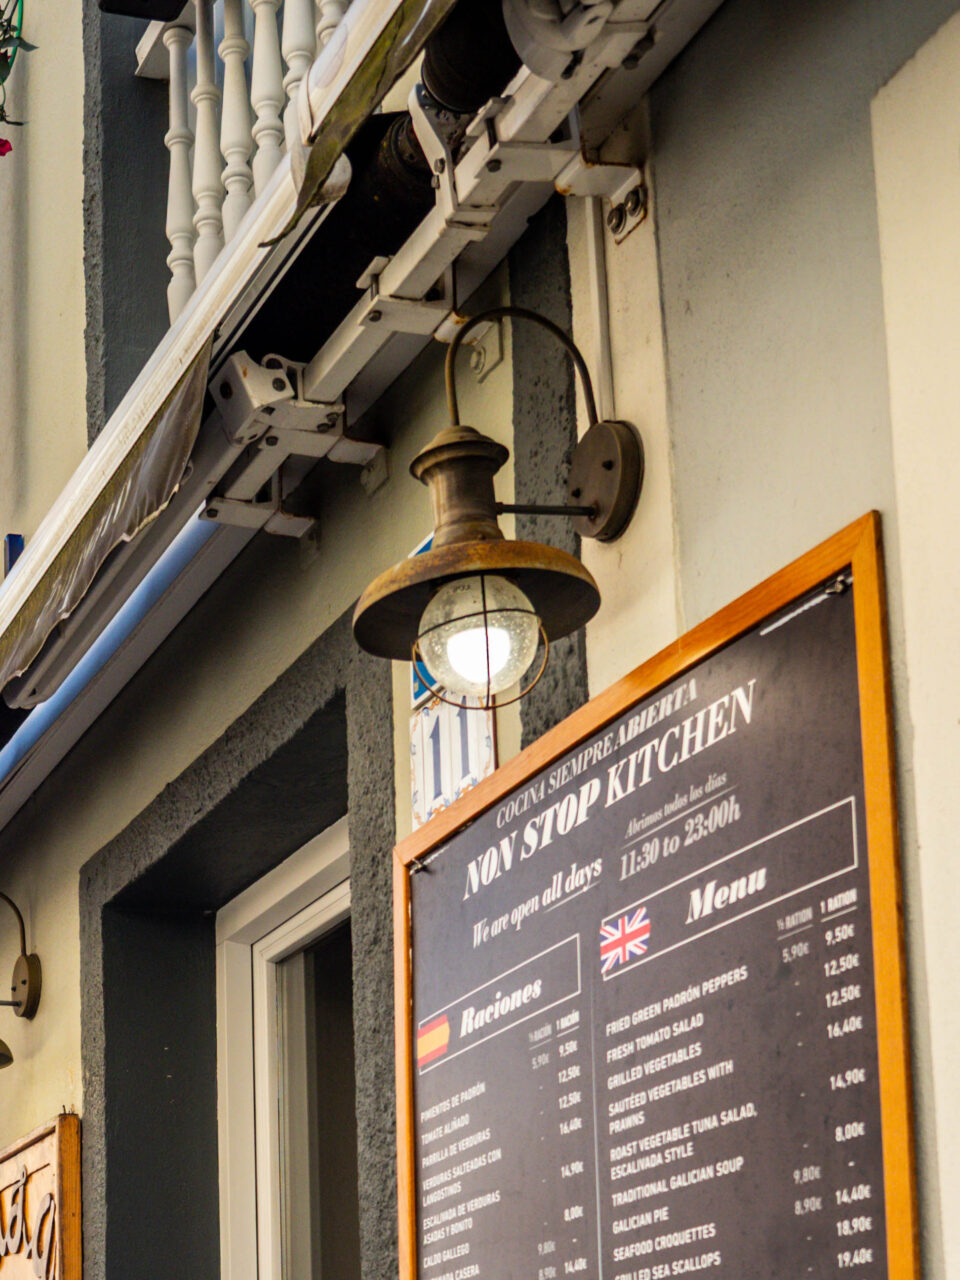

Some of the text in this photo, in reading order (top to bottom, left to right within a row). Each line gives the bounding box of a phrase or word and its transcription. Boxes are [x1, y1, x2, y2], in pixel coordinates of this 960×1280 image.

[429, 694, 471, 801] 11
[496, 678, 698, 828] COCINA SIEMPRE ABIERTA
[463, 680, 753, 899] NON STOP KITCHEN
[624, 773, 726, 838] Abrimos todos los días
[620, 796, 739, 880] 11:30 to 23:00h
[473, 858, 601, 947] We are open all days
[686, 868, 765, 923] Menu
[783, 907, 812, 928] RATION
[819, 888, 856, 913] 1 RATION
[824, 923, 853, 945] 9,50€
[823, 953, 858, 976] 12,50€
[460, 980, 540, 1036] Raciones
[605, 965, 747, 1036] FRIED GREEN PADRÓN PEPPERS
[606, 1012, 703, 1062] FRESH TOMATO SALAD
[826, 1016, 862, 1038] 16,40€
[607, 1042, 701, 1089] GRILLED VEGETABLES
[608, 1059, 733, 1116] SAUTÉED VEGETABLES WITH
[608, 1111, 644, 1134] PRAWNS
[609, 1141, 637, 1161] ROAST
[638, 1123, 689, 1150] VEGETABLE
[691, 1114, 718, 1133] TUNA
[834, 1121, 864, 1141] 8,00€
[610, 1141, 693, 1179] ESCALIVADA STYLE
[611, 1156, 743, 1205] TRADITIONAL GALICIAN SOUP
[835, 1184, 870, 1204] 14,40€
[612, 1206, 668, 1233] GALICIAN PIE
[613, 1223, 715, 1261] SEAFOOD CROQUETTES
[651, 1263, 670, 1279] SEA
[671, 1251, 720, 1274] SCALLOPS
